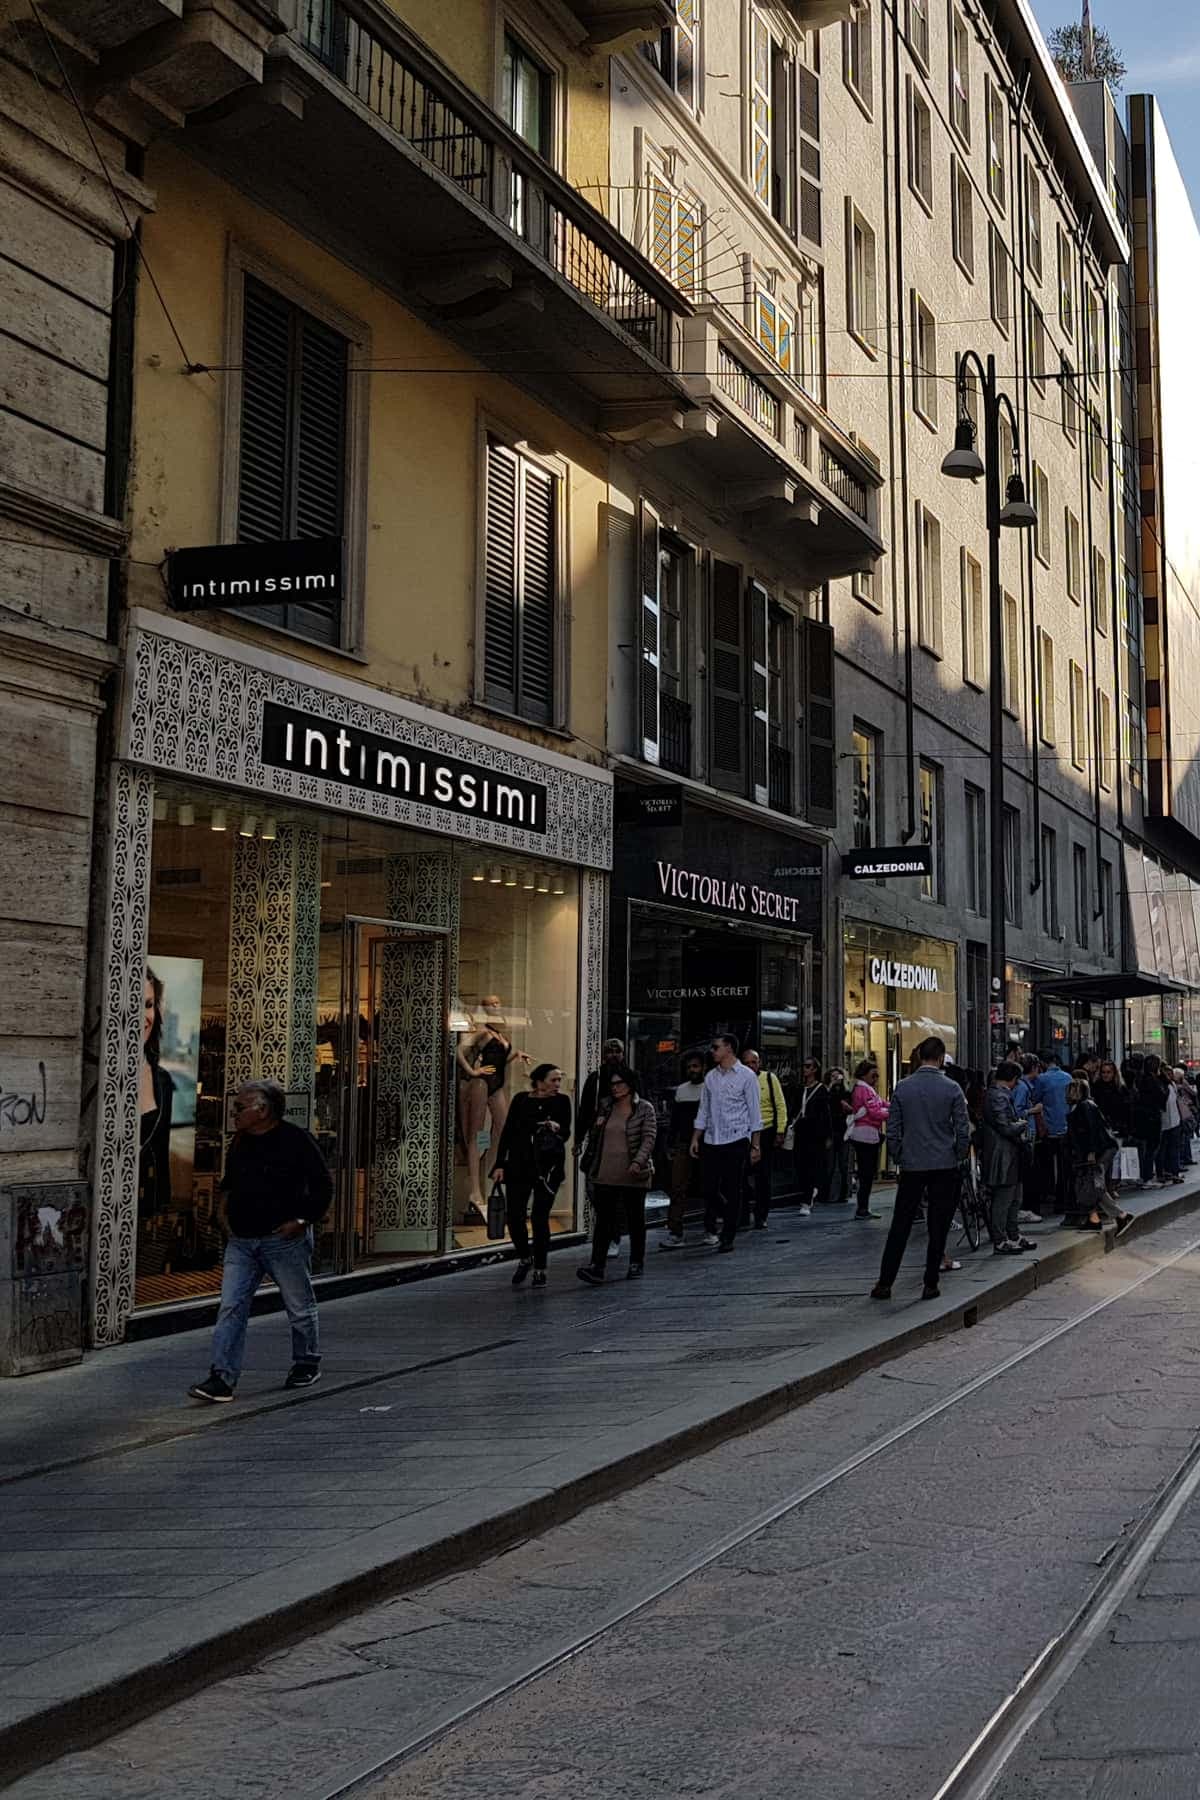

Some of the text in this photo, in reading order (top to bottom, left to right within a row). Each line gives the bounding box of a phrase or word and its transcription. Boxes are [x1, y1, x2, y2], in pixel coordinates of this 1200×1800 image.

[854, 861, 926, 875] CALZEDONIA
[656, 860, 800, 923] VICTORIA'S SECRET
[871, 957, 939, 993] CALZEDONIA
[710, 985, 752, 998] SECRET
